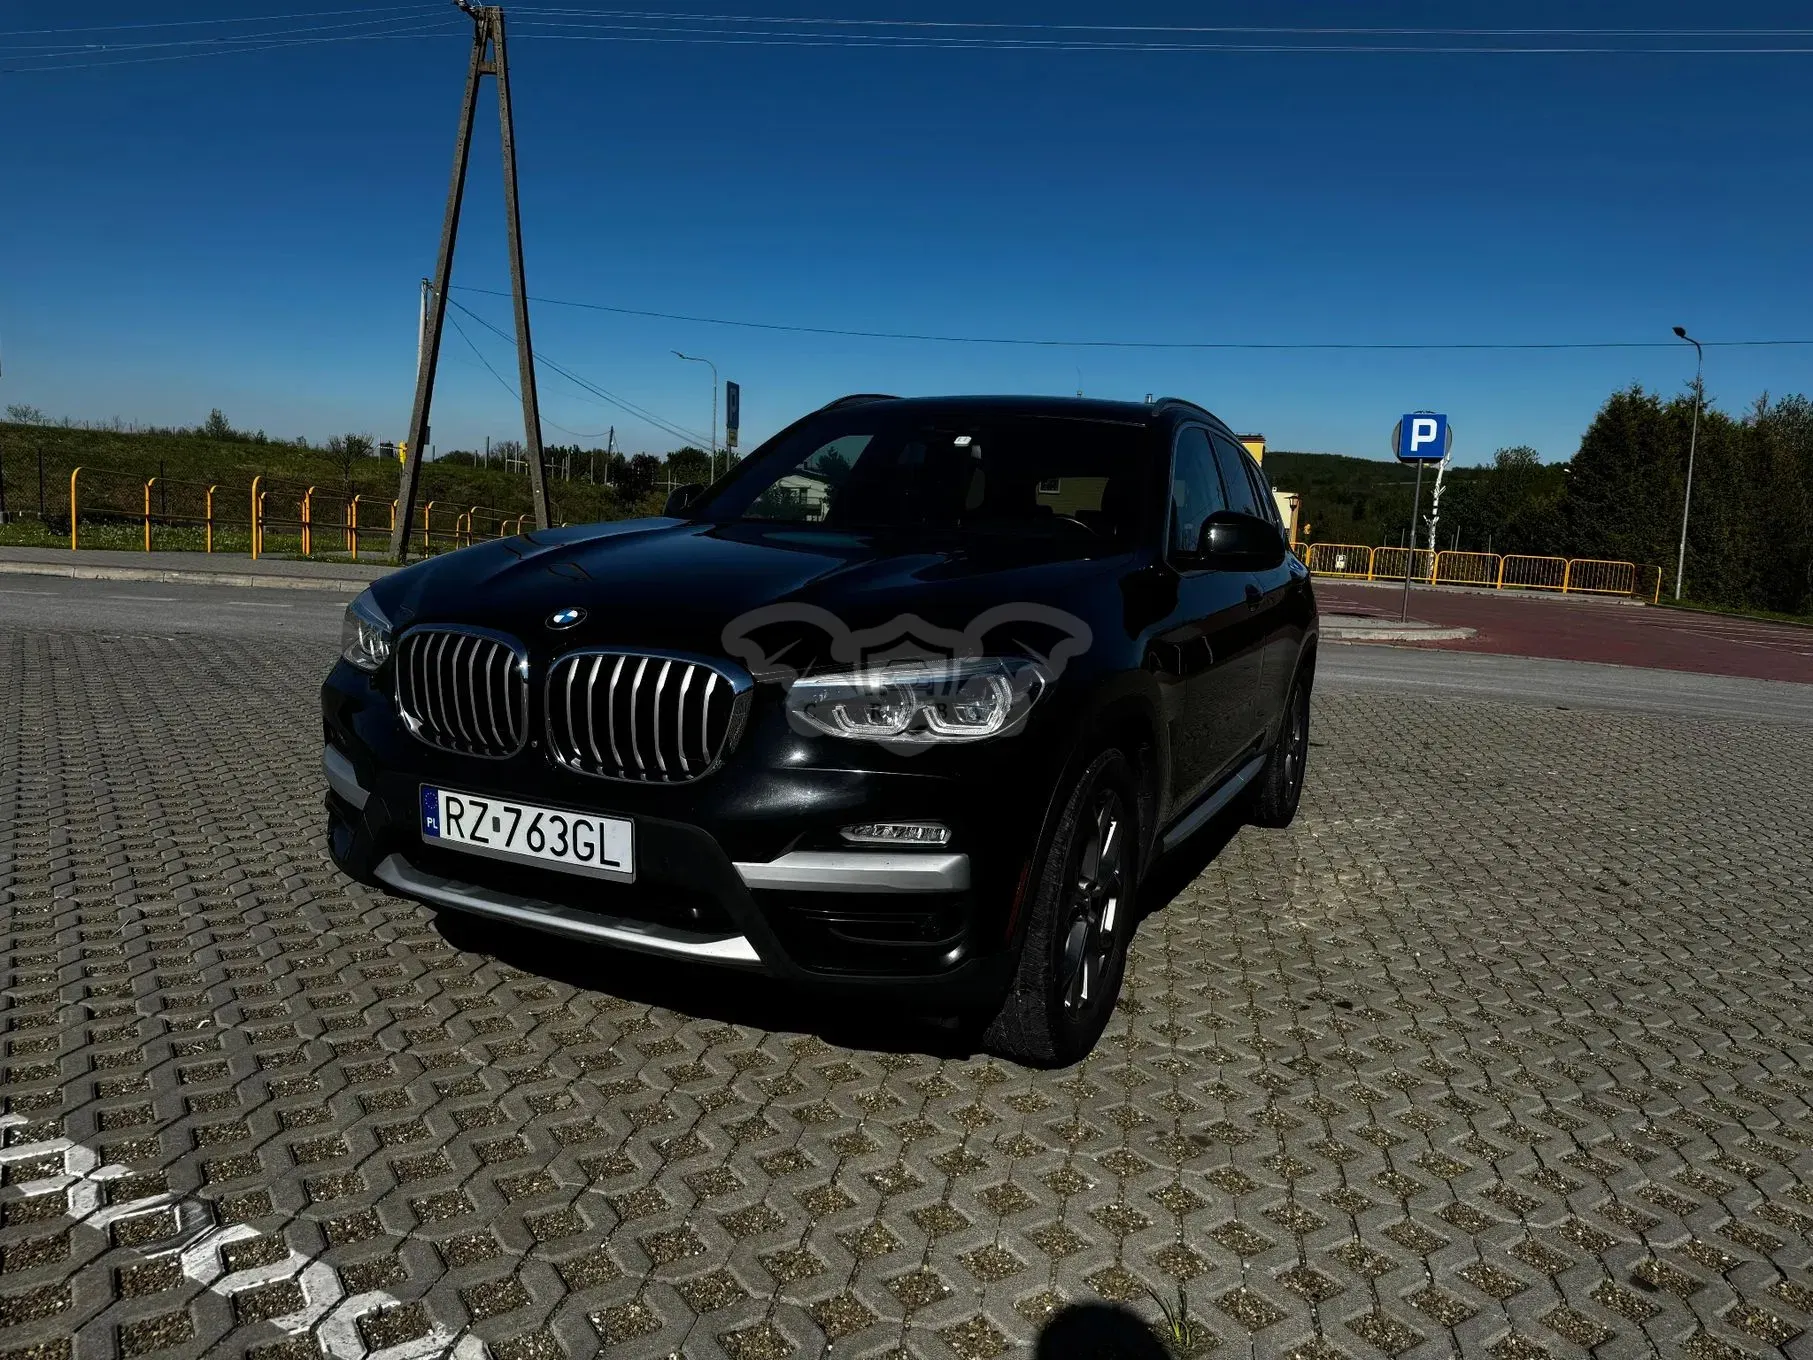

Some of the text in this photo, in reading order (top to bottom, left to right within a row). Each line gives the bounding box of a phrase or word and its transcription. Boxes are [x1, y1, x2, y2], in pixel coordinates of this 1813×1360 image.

[1410, 418, 1437, 451] P
[427, 817, 438, 829] PL
[445, 796, 620, 867] RZ 763GL
